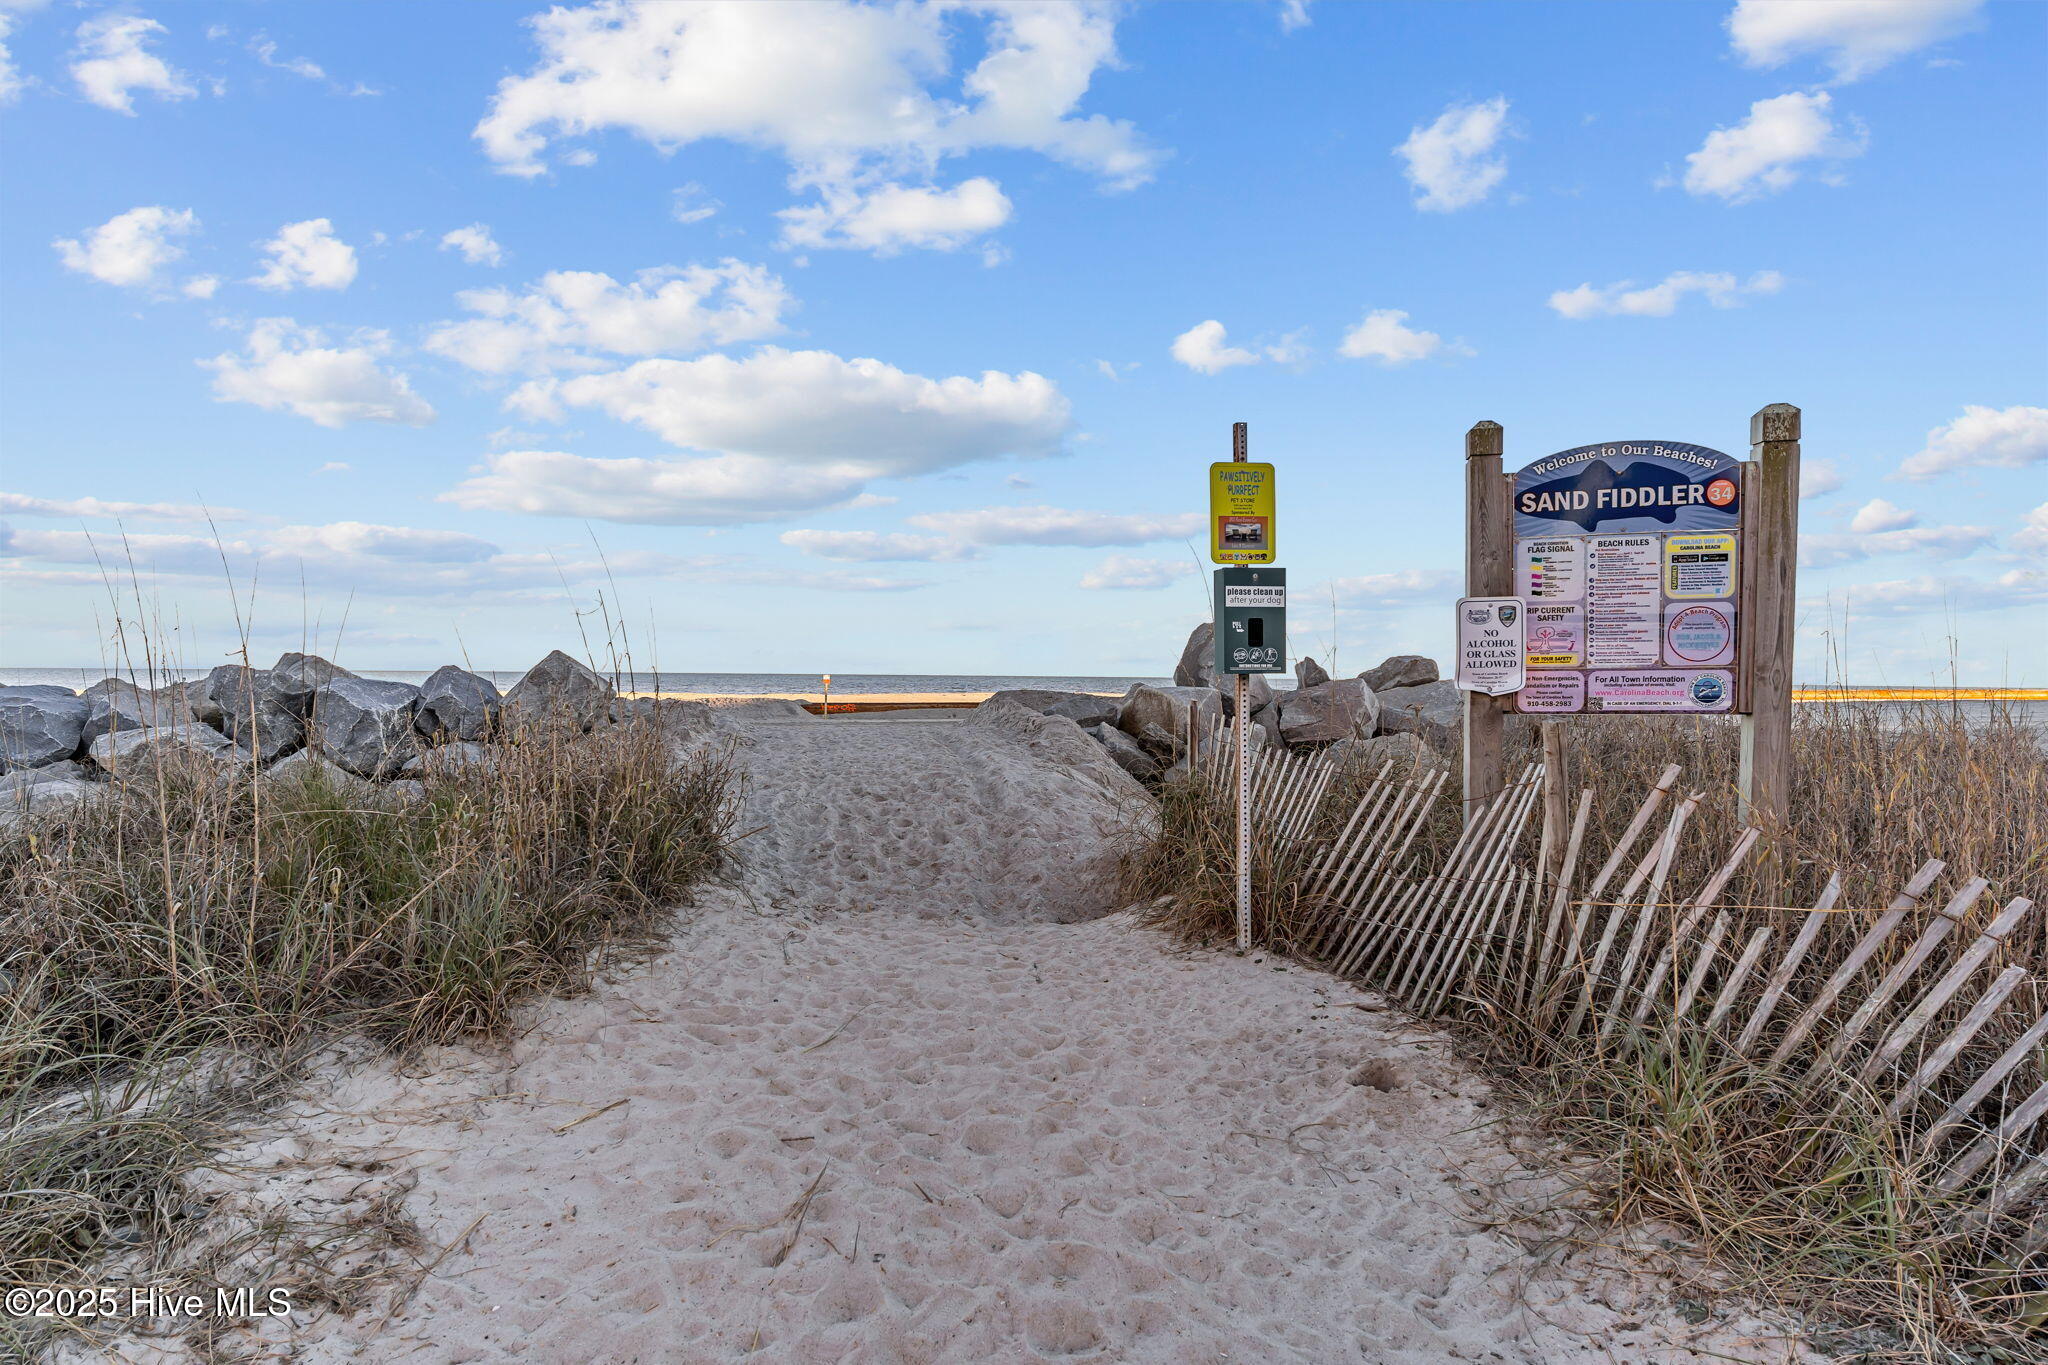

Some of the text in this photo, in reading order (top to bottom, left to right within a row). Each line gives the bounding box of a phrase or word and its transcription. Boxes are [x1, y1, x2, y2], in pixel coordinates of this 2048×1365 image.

[1533, 444, 1718, 475] Welcome to Our Beaches!
[1220, 470, 1265, 482] PAWSITIVELY
[1228, 485, 1259, 496] PURRFECT
[1521, 484, 1732, 513] SAND FIDDLER 34
[1227, 588, 1251, 596] please
[1709, 611, 1727, 629] Program
[1467, 640, 1516, 648] ALCOHOL
[1465, 660, 1517, 668] ALLOWED
